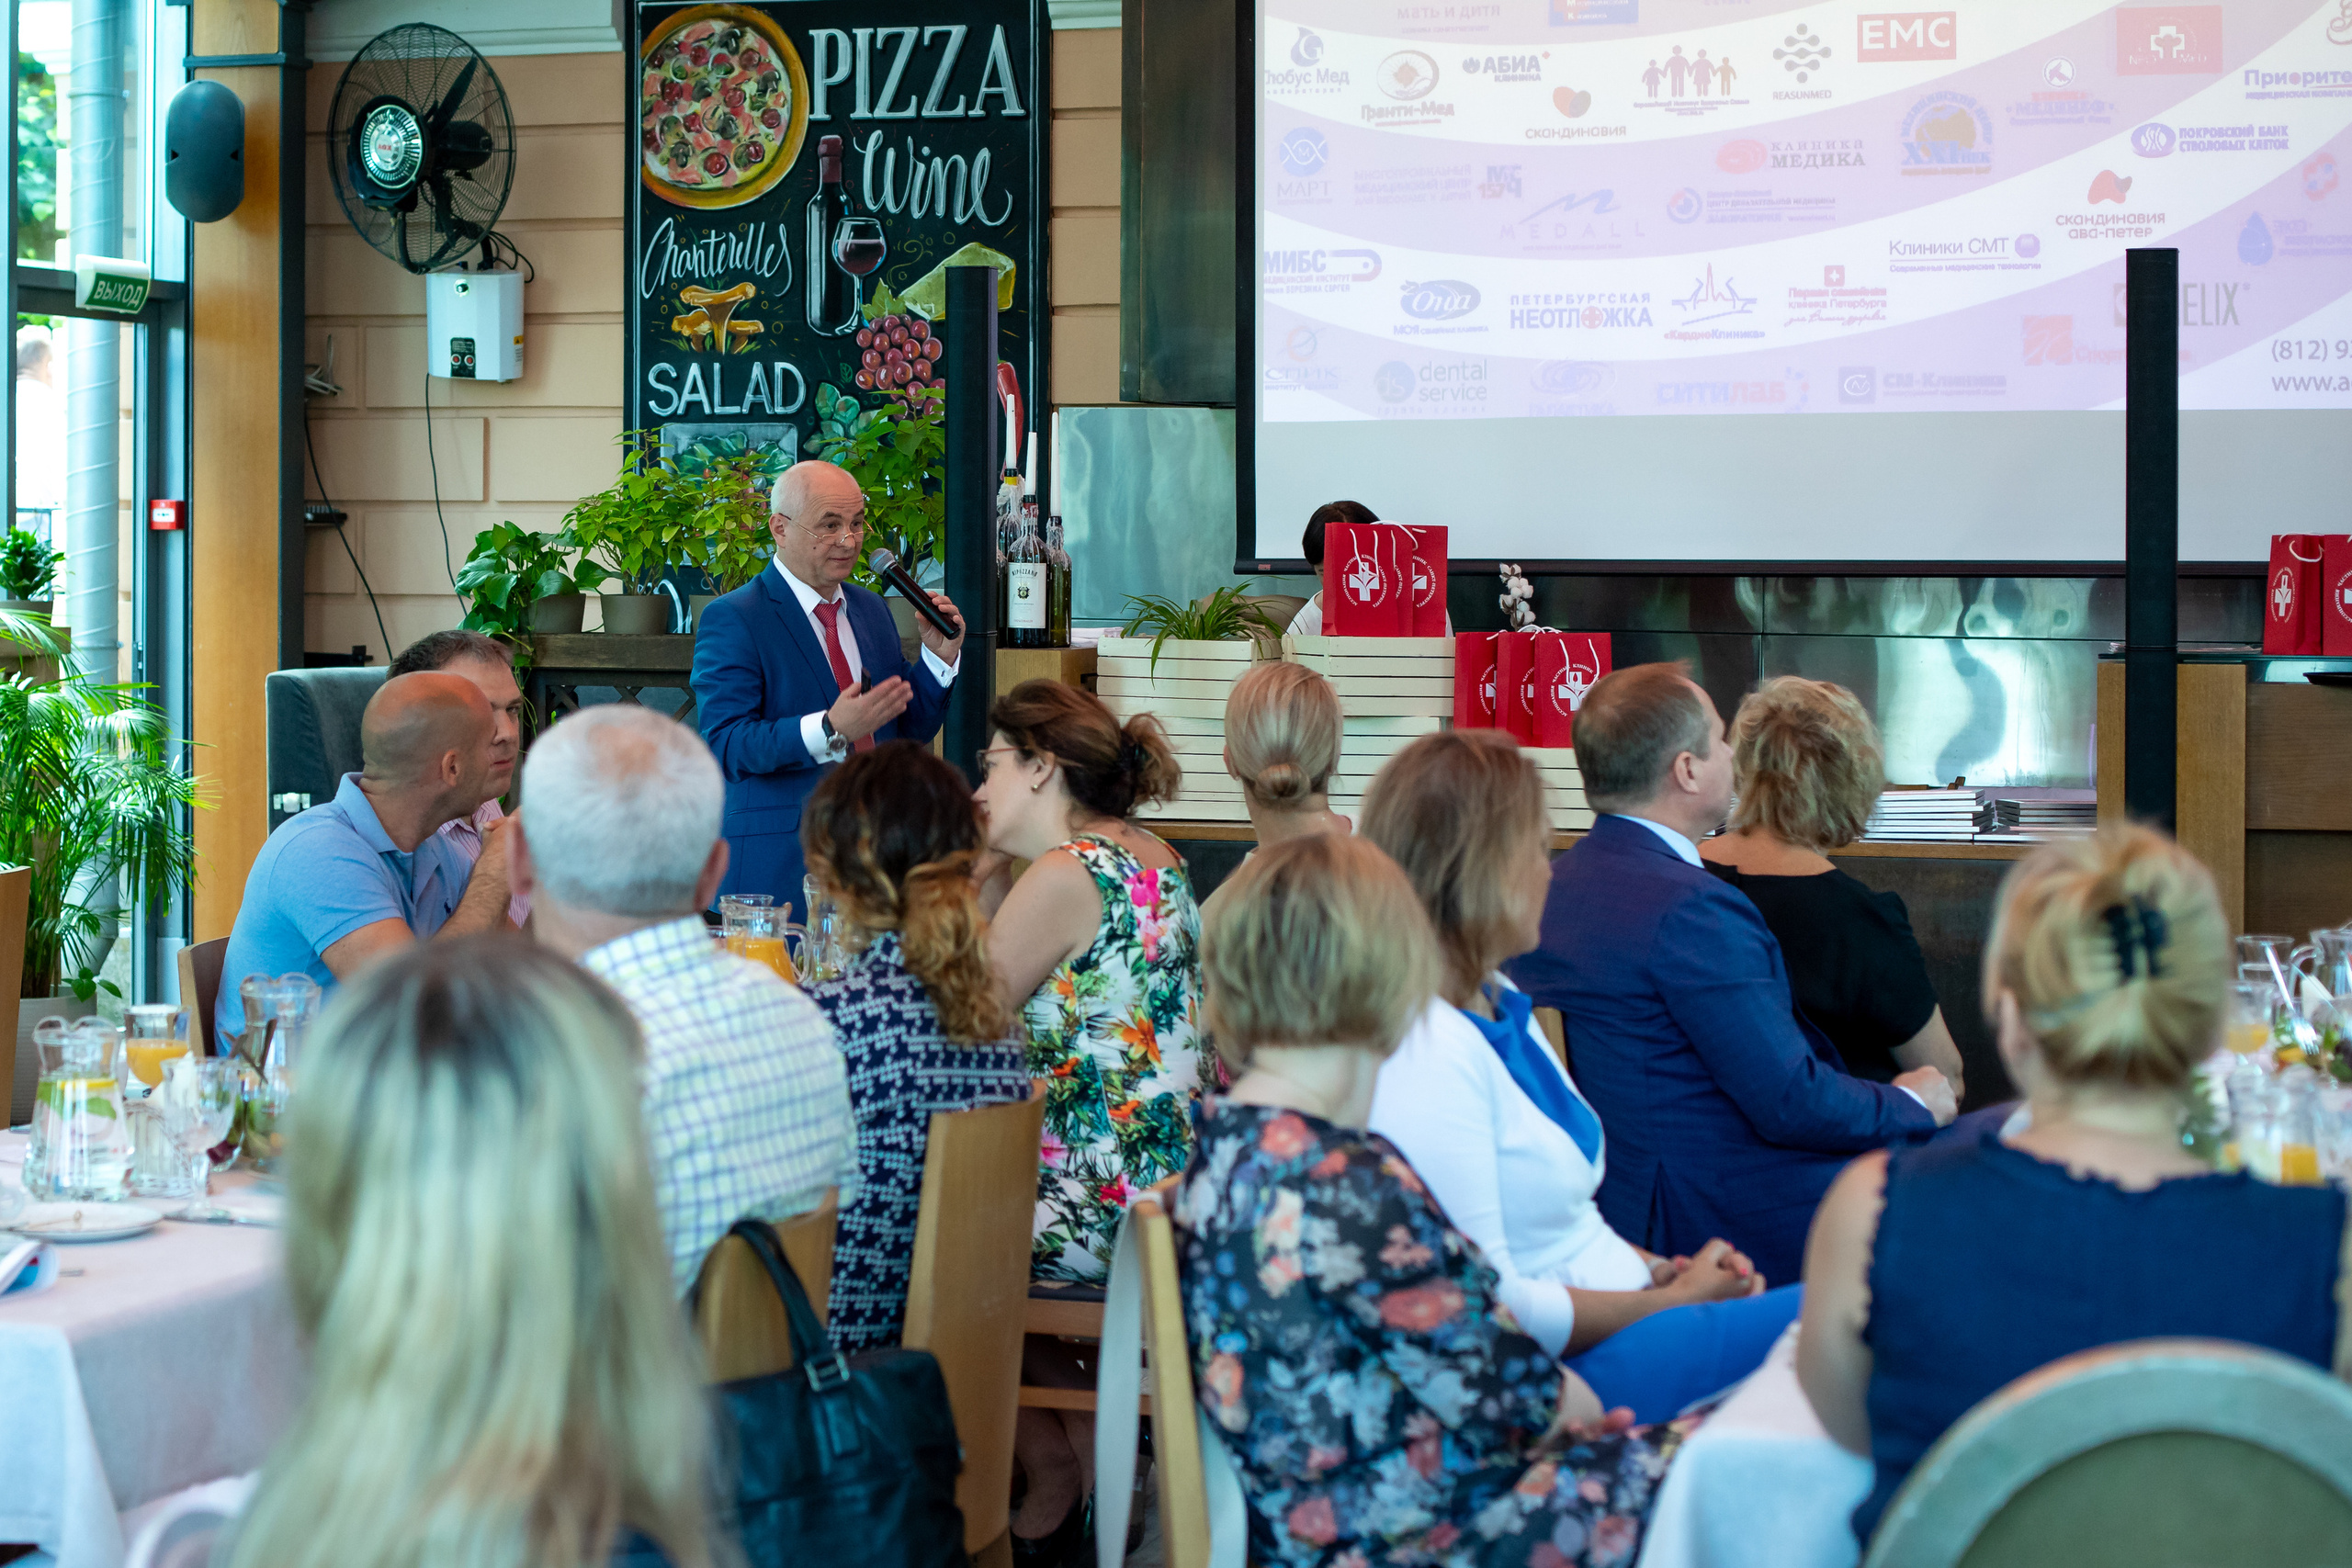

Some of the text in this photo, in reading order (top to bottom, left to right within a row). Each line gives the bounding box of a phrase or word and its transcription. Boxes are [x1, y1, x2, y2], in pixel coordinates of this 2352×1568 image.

[1862, 17, 1951, 50] EMC
[808, 25, 1026, 120] PIZZA
[1483, 55, 1542, 73] АБИА
[1317, 68, 1350, 85] Мед
[2245, 69, 2352, 88] Приорите
[2259, 125, 2289, 137] БАНК
[1771, 152, 1866, 170] МЕДИКА
[854, 130, 1013, 227] Wine
[1277, 180, 1333, 197] МАРТ
[1889, 237, 2009, 256] Клиники СМТ
[643, 217, 793, 299] Chanterelles
[1264, 249, 1327, 274] МИБС
[94, 280, 143, 308] ВЫХОД
[1510, 292, 1651, 305] ПЕТЕРБУРГСКАЯ
[2183, 282, 2240, 326] ELIX
[2272, 339, 2352, 362] (812) 9
[1419, 358, 1487, 381] dental
[648, 362, 806, 416] SALAD
[1419, 383, 1487, 402] service
[2272, 376, 2352, 391] www.a
